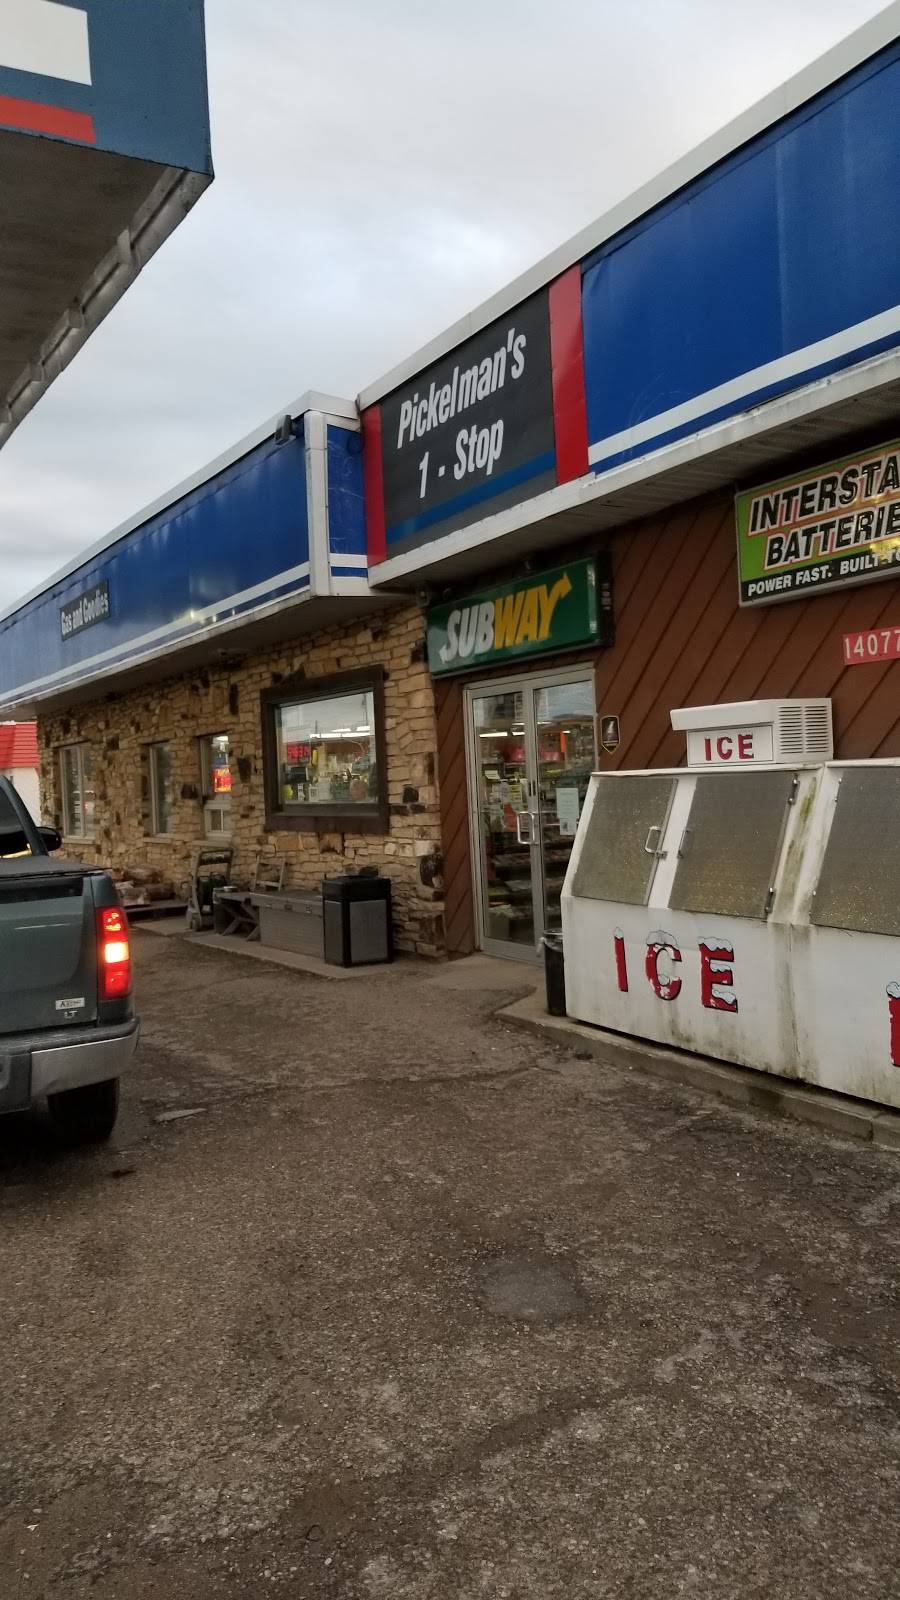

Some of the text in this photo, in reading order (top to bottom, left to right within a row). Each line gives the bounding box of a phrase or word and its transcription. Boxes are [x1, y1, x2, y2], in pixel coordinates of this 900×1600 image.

[397, 327, 527, 449] Pickelman's
[418, 451, 430, 499] 1
[453, 419, 505, 480] Stop
[749, 453, 900, 536] INTERSTA
[765, 501, 900, 570] BATTERIE
[747, 575, 792, 597] POWER
[796, 564, 833, 586] FAST.
[839, 553, 880, 575] BUILT
[61, 589, 109, 636] Gas and Goodies
[439, 572, 573, 665] SUBWAY
[844, 629, 900, 659] 14077
[704, 734, 754, 761] ICE
[613, 926, 739, 1014] ICE
